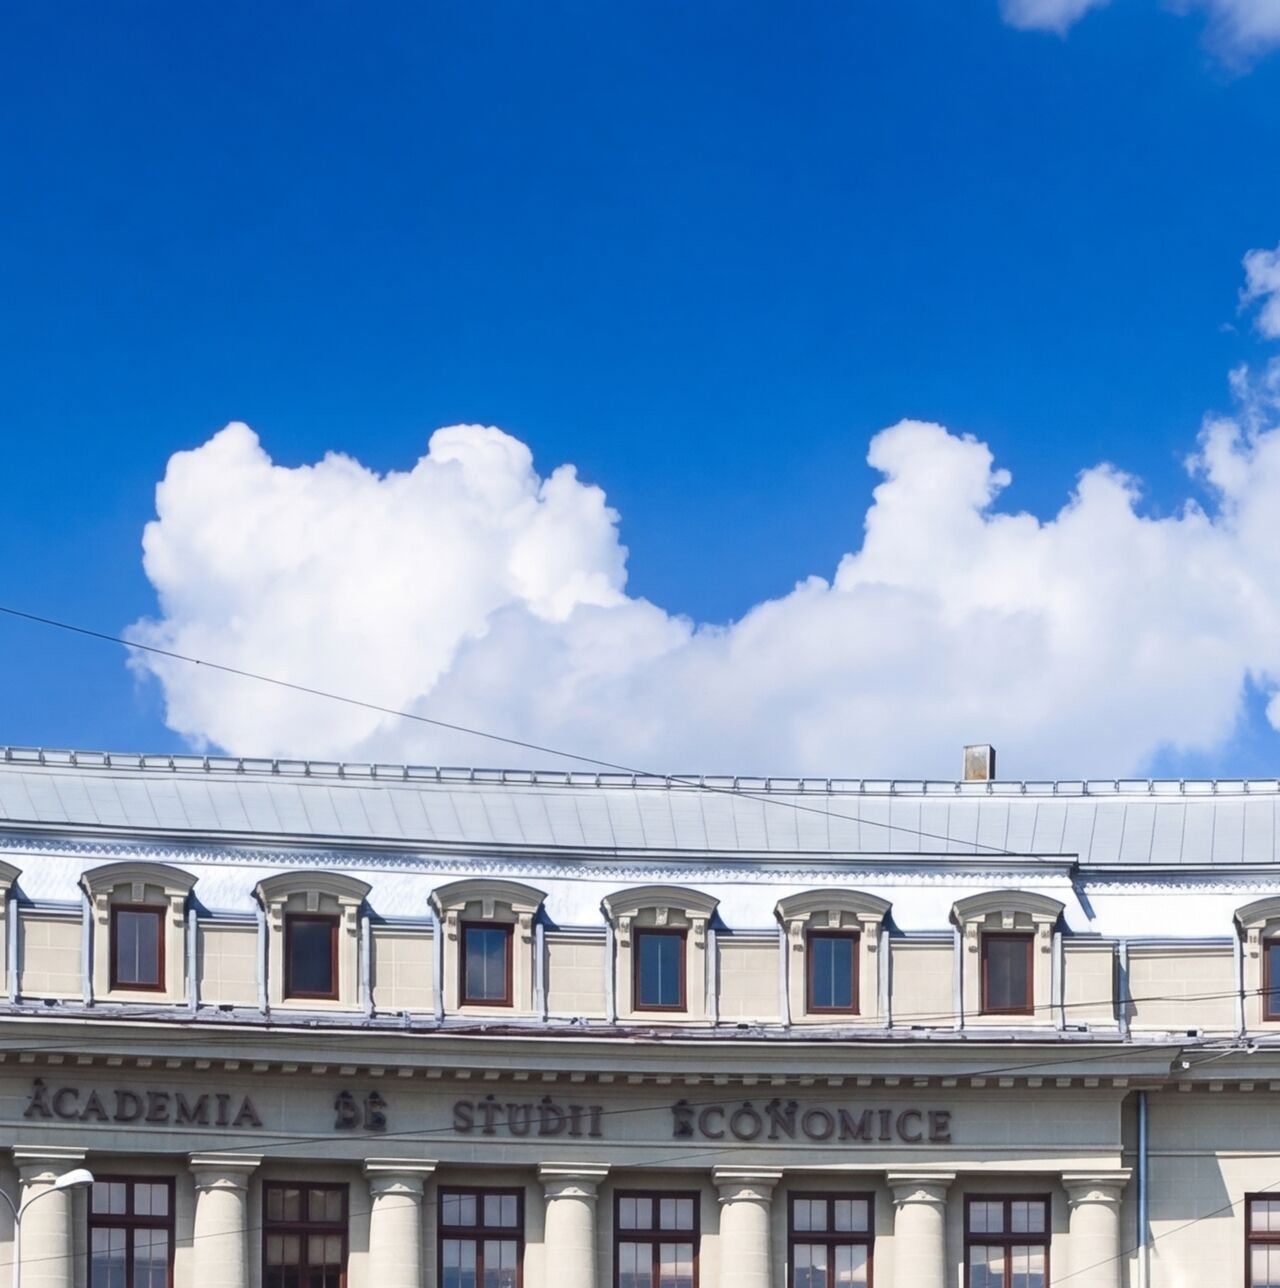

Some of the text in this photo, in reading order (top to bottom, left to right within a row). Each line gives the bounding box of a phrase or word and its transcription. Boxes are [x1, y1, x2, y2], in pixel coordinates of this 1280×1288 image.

[23, 1084, 953, 1142] ACADEMIA DE STUDII ECONOMICE
